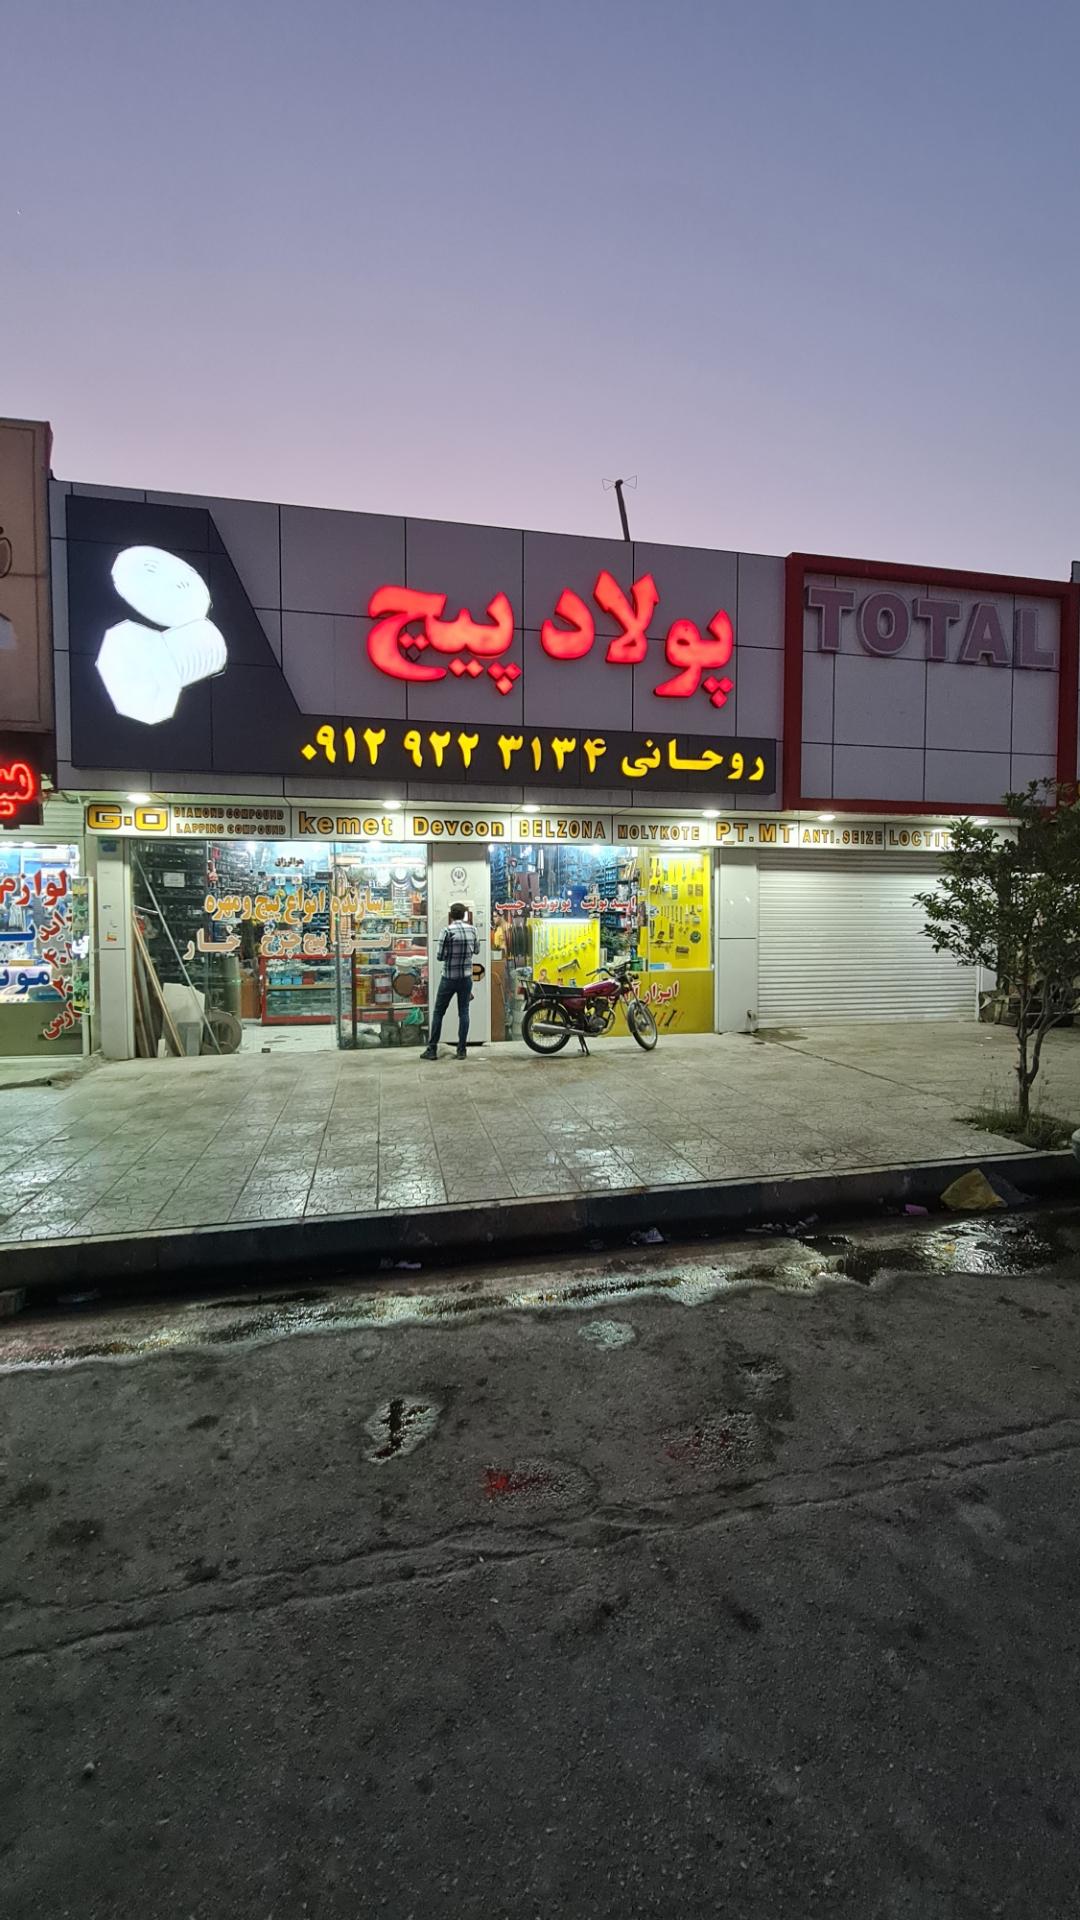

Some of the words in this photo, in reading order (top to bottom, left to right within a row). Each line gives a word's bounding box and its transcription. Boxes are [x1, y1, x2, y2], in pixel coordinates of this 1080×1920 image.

[366, 584, 522, 696] پیچ
[540, 568, 735, 708] پولاد
[805, 585, 1059, 671] TOTAL
[301, 724, 387, 766] ۰۹۱۲
[403, 730, 480, 769] ۹۲۲
[497, 735, 607, 774] ۳۱۳۴
[620, 738, 766, 782] روحانی
[173, 806, 224, 819] DIAMOND
[226, 808, 285, 820] COMPOUND
[176, 823, 224, 834] LAPPING
[227, 824, 287, 835] COMPOUND
[298, 811, 393, 835] kemet
[413, 816, 505, 837] Devcon
[519, 820, 606, 839] BELZONA
[617, 824, 700, 840] MOLYKOTE
[889, 829, 962, 848] LOCTIT
[284, 887, 325, 924] انواع
